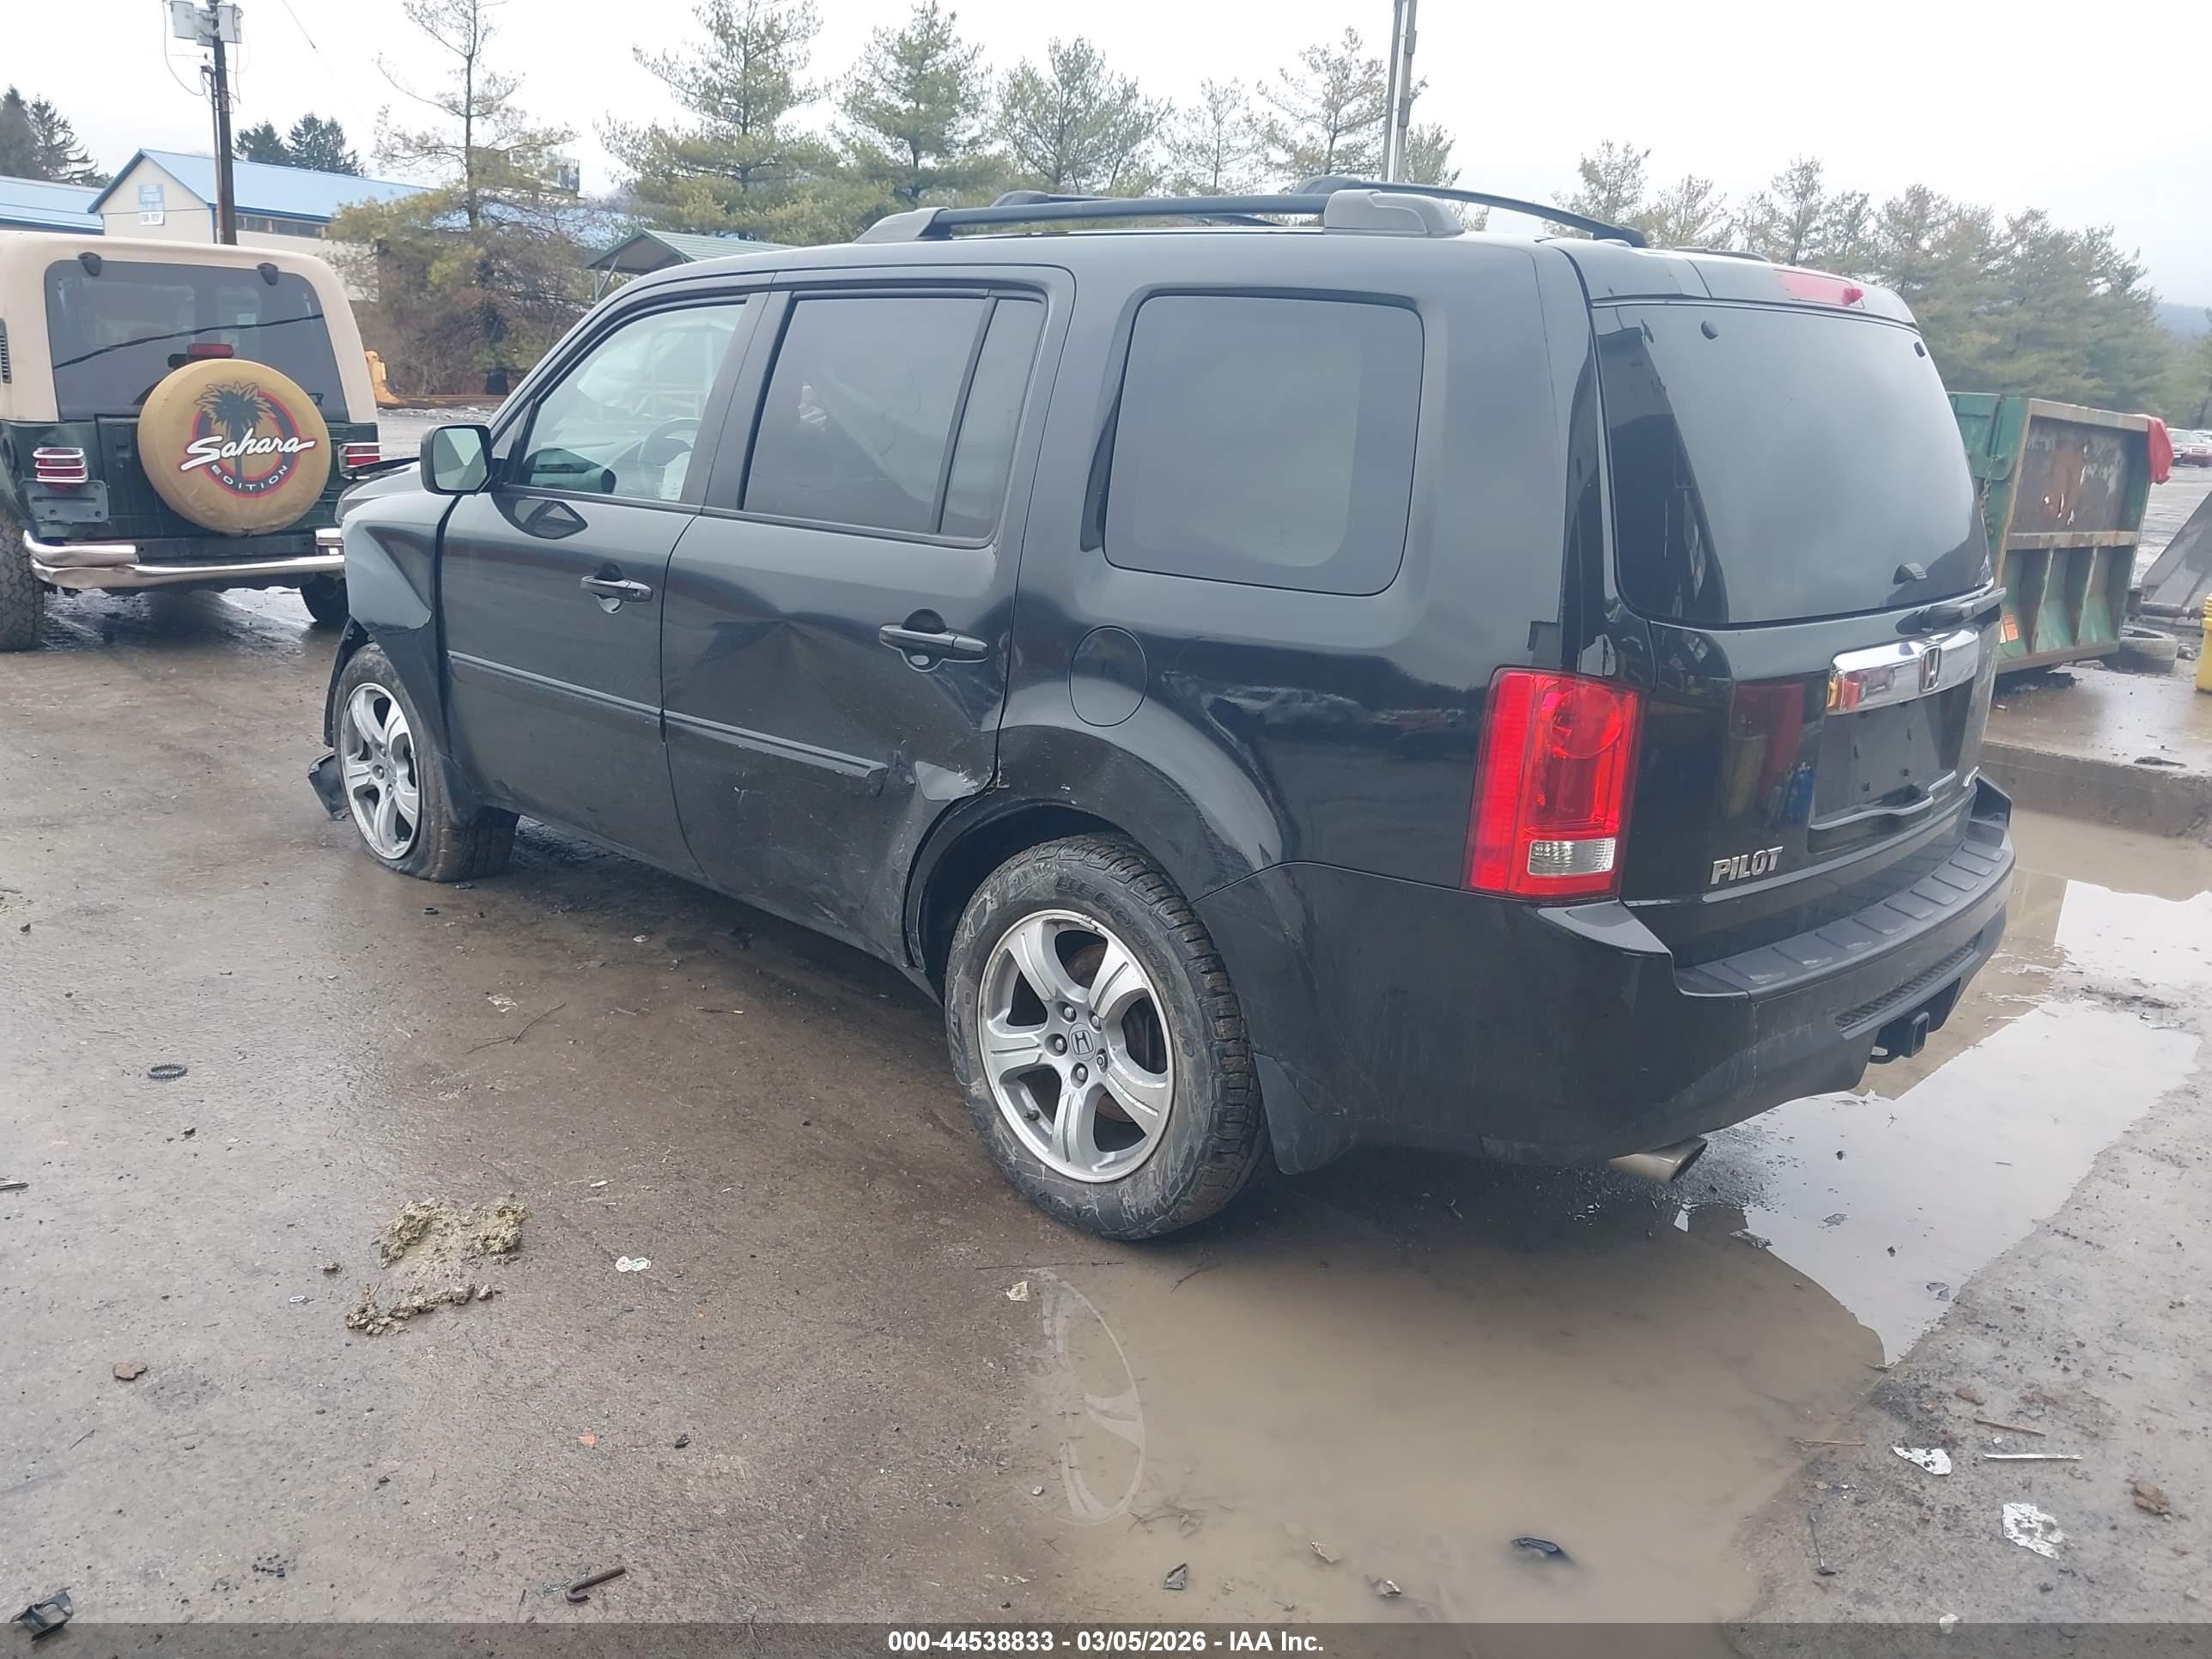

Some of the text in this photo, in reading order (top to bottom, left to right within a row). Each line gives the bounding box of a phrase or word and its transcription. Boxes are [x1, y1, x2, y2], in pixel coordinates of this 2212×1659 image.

[180, 428, 315, 471] Sahara
[211, 465, 289, 490] EDITION
[1710, 846, 1784, 885] PILOT
